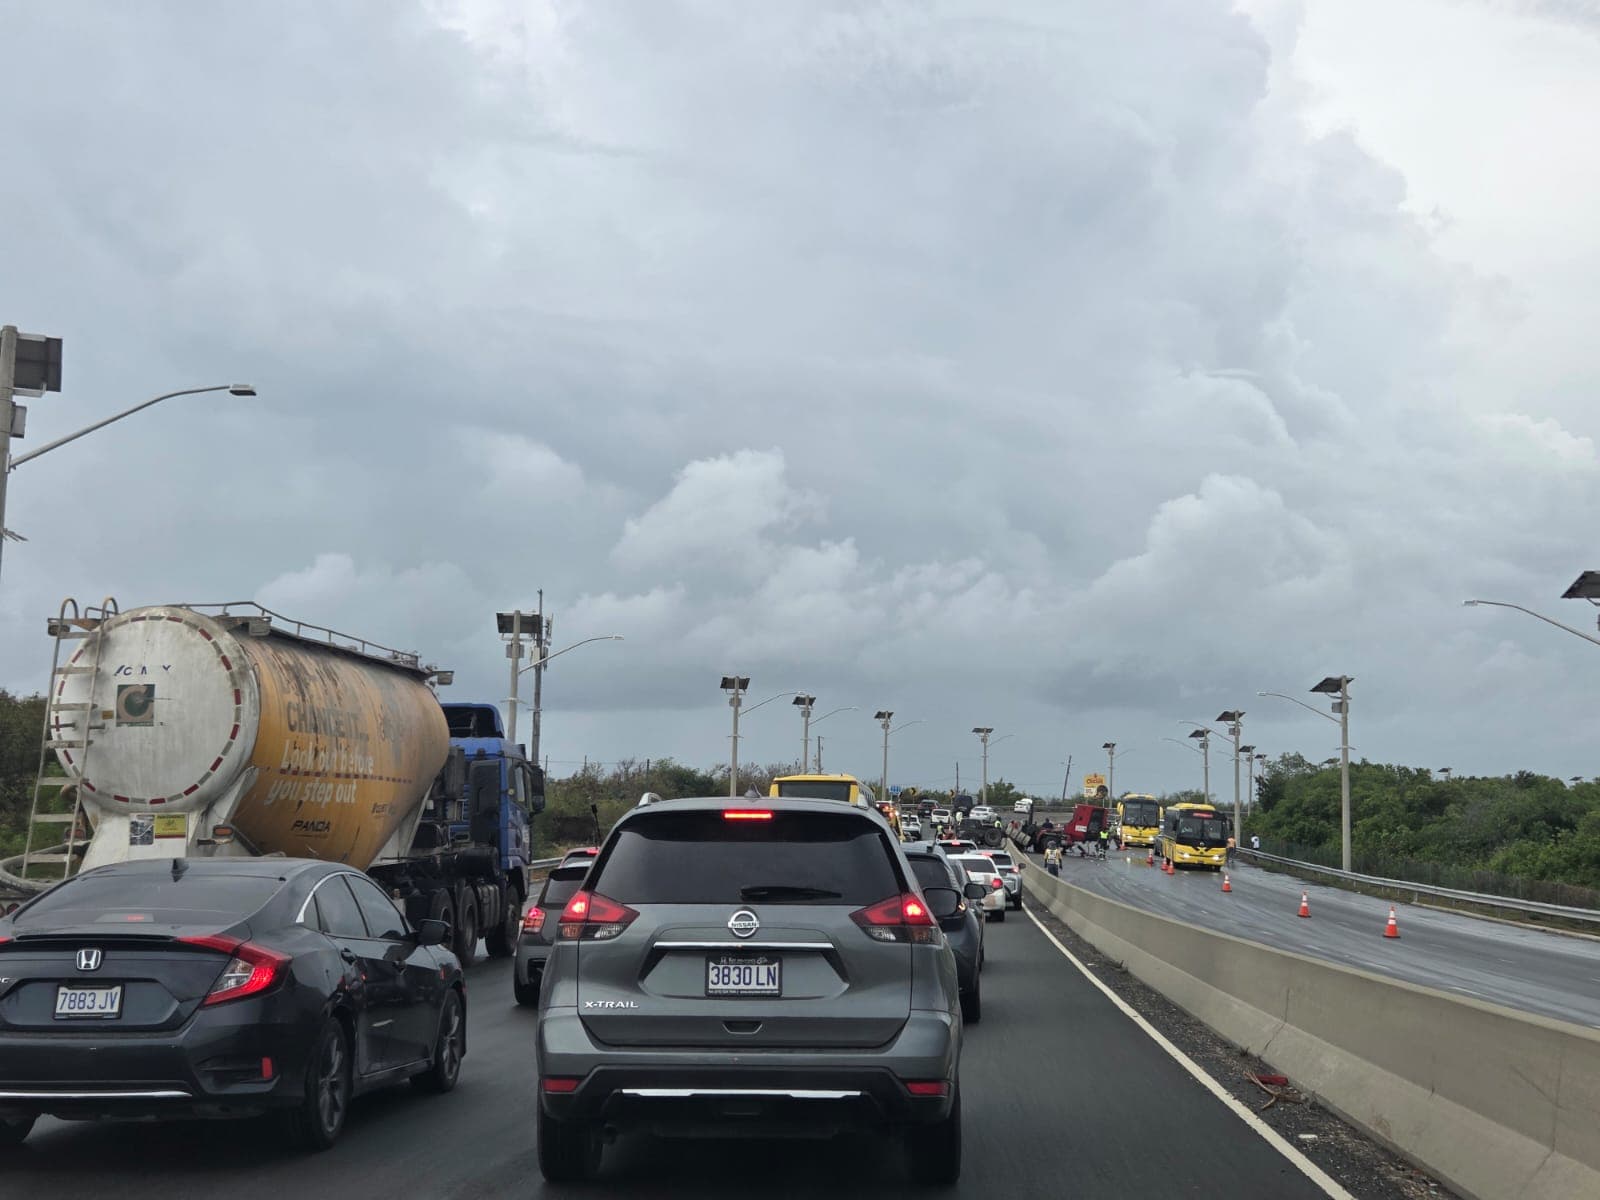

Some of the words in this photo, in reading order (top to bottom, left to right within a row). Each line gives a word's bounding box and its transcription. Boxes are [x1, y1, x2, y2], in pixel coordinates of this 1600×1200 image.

[264, 779, 300, 806] you
[303, 777, 334, 808] step
[336, 779, 358, 804] out
[710, 965, 752, 986] 3830
[756, 965, 777, 987] LN
[59, 991, 97, 1010] 7883
[98, 991, 118, 1010] JV
[584, 1000, 639, 1009] X-TRAIL
